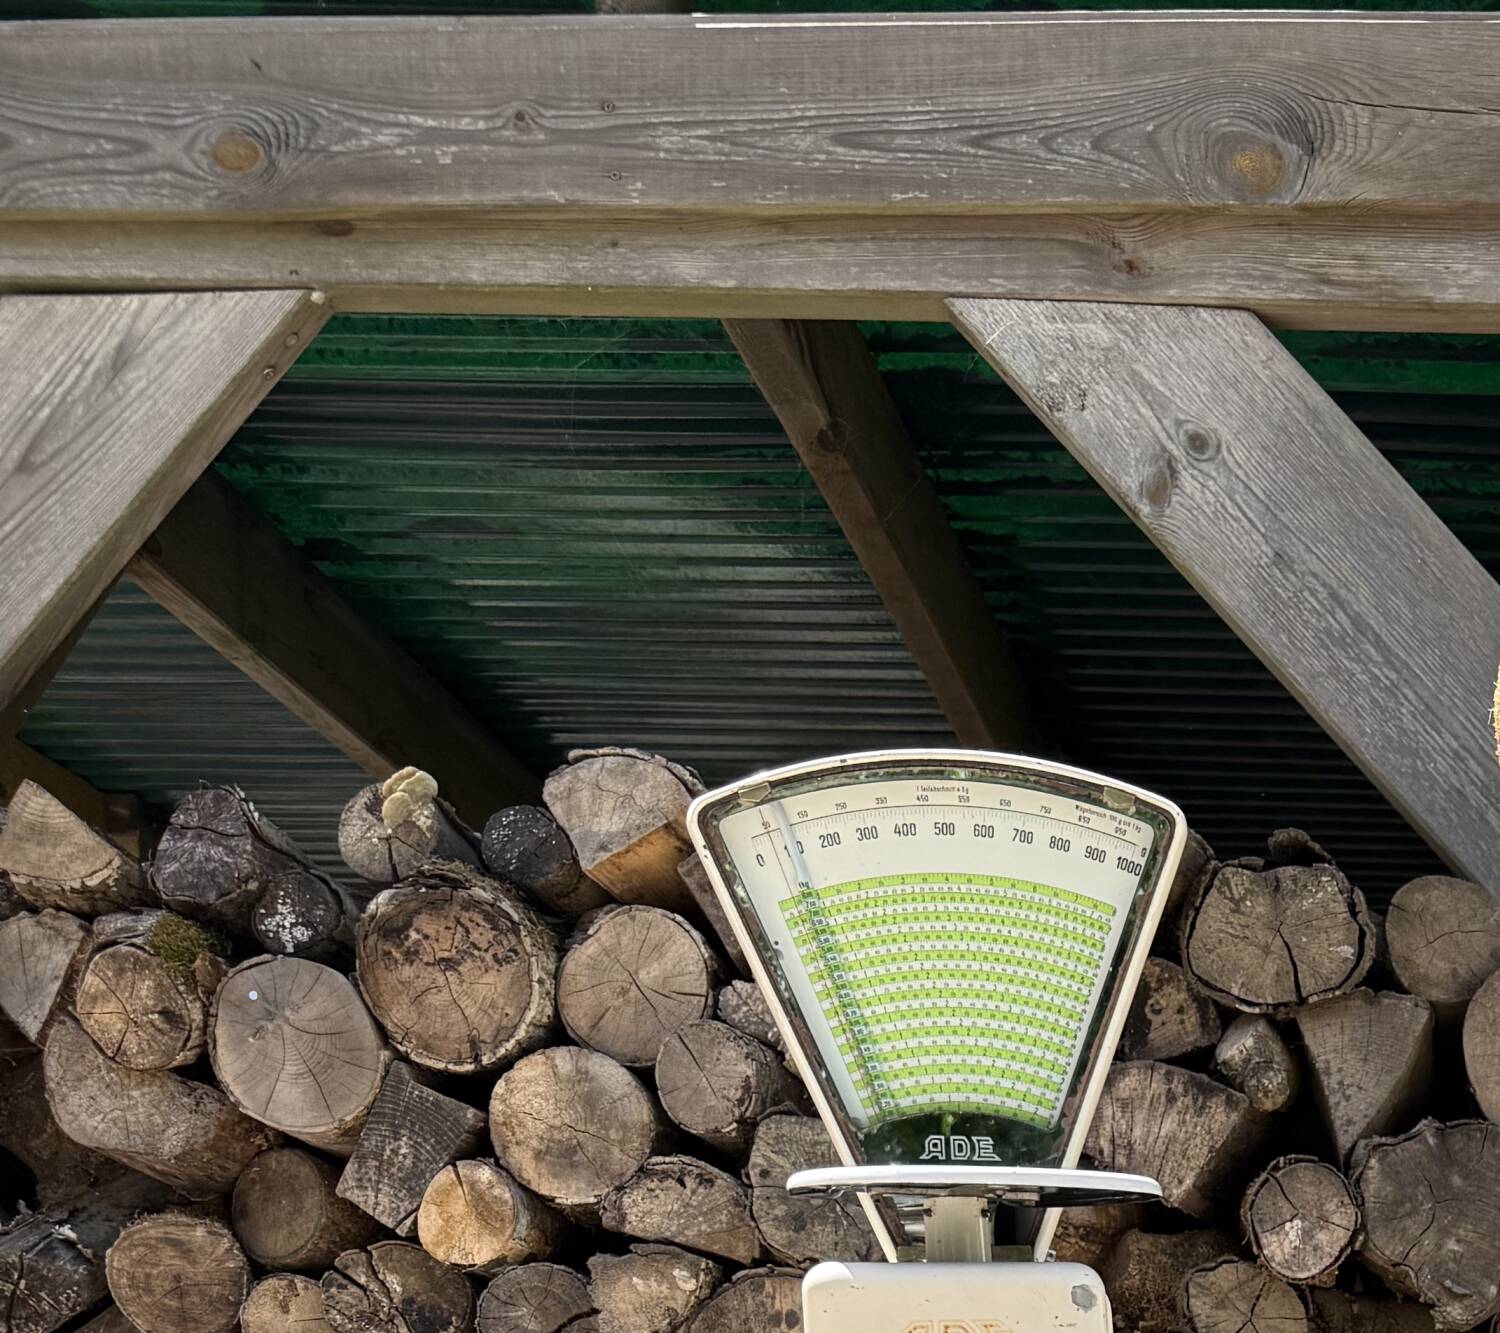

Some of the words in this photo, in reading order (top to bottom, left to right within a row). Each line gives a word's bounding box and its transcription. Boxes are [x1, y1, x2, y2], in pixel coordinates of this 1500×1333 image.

[756, 853, 766, 867] 0
[818, 831, 841, 848] 200
[855, 825, 879, 842] 300
[893, 822, 917, 838] 400
[934, 821, 956, 836] 500
[973, 823, 995, 839] 600
[1011, 828, 1034, 845] 700
[1048, 835, 1071, 853] 800
[1084, 845, 1107, 864] 900
[1116, 856, 1143, 877] 1000
[919, 1134, 1003, 1162] ADE
